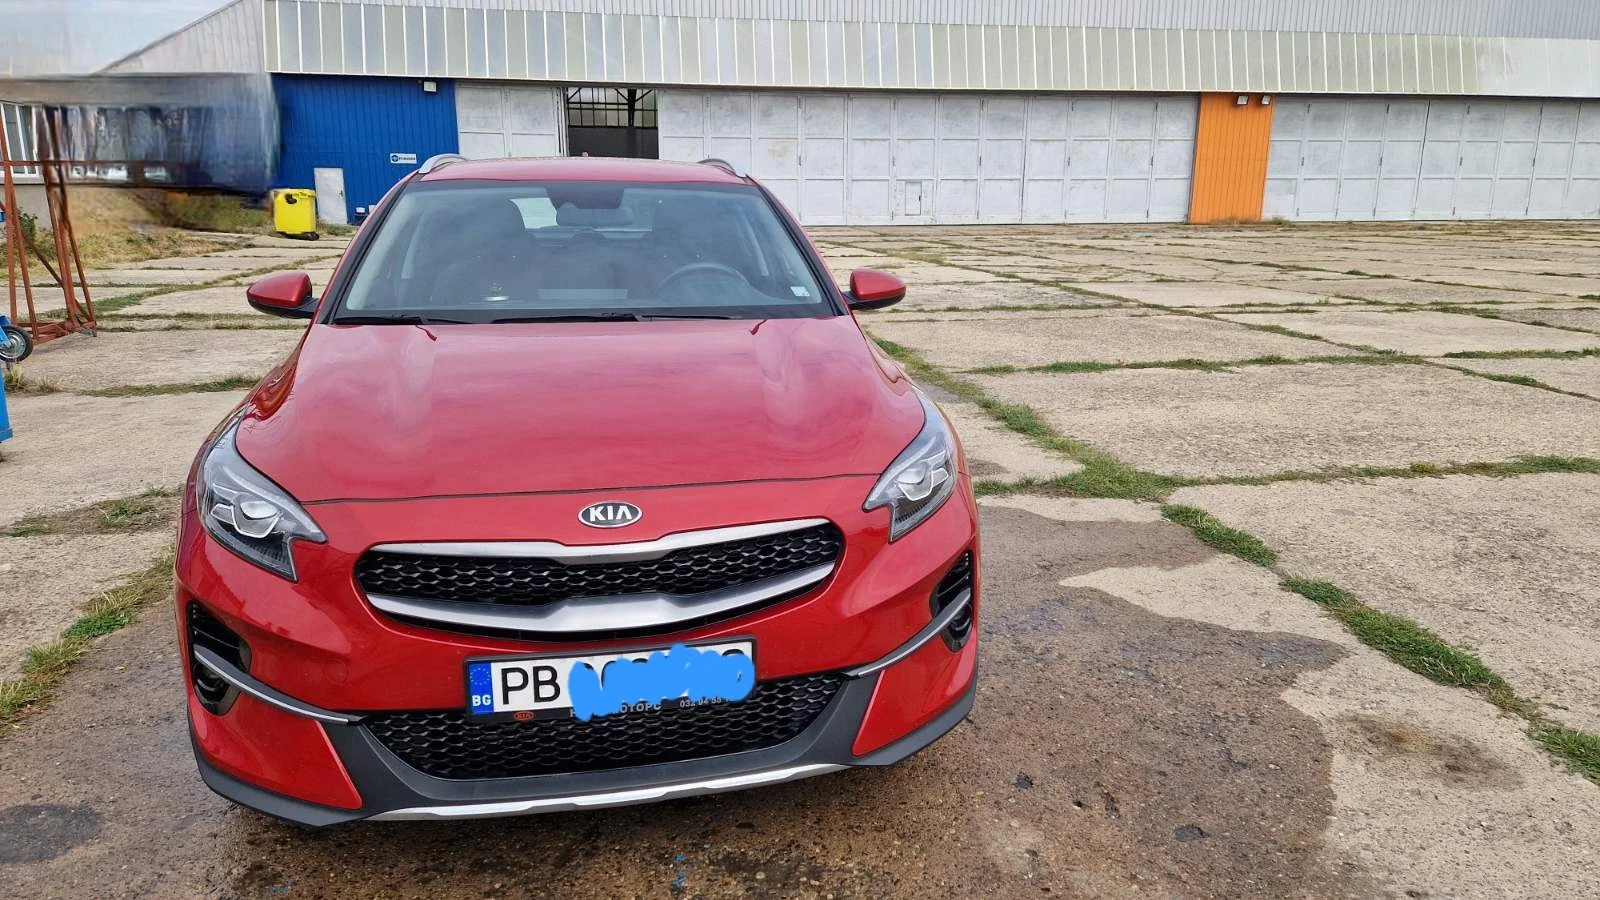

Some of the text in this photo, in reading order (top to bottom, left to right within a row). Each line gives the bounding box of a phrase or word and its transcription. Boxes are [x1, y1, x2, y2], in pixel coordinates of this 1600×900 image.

[589, 505, 632, 521] KIA
[471, 694, 492, 707] BG
[616, 702, 662, 713] ОТОРС
